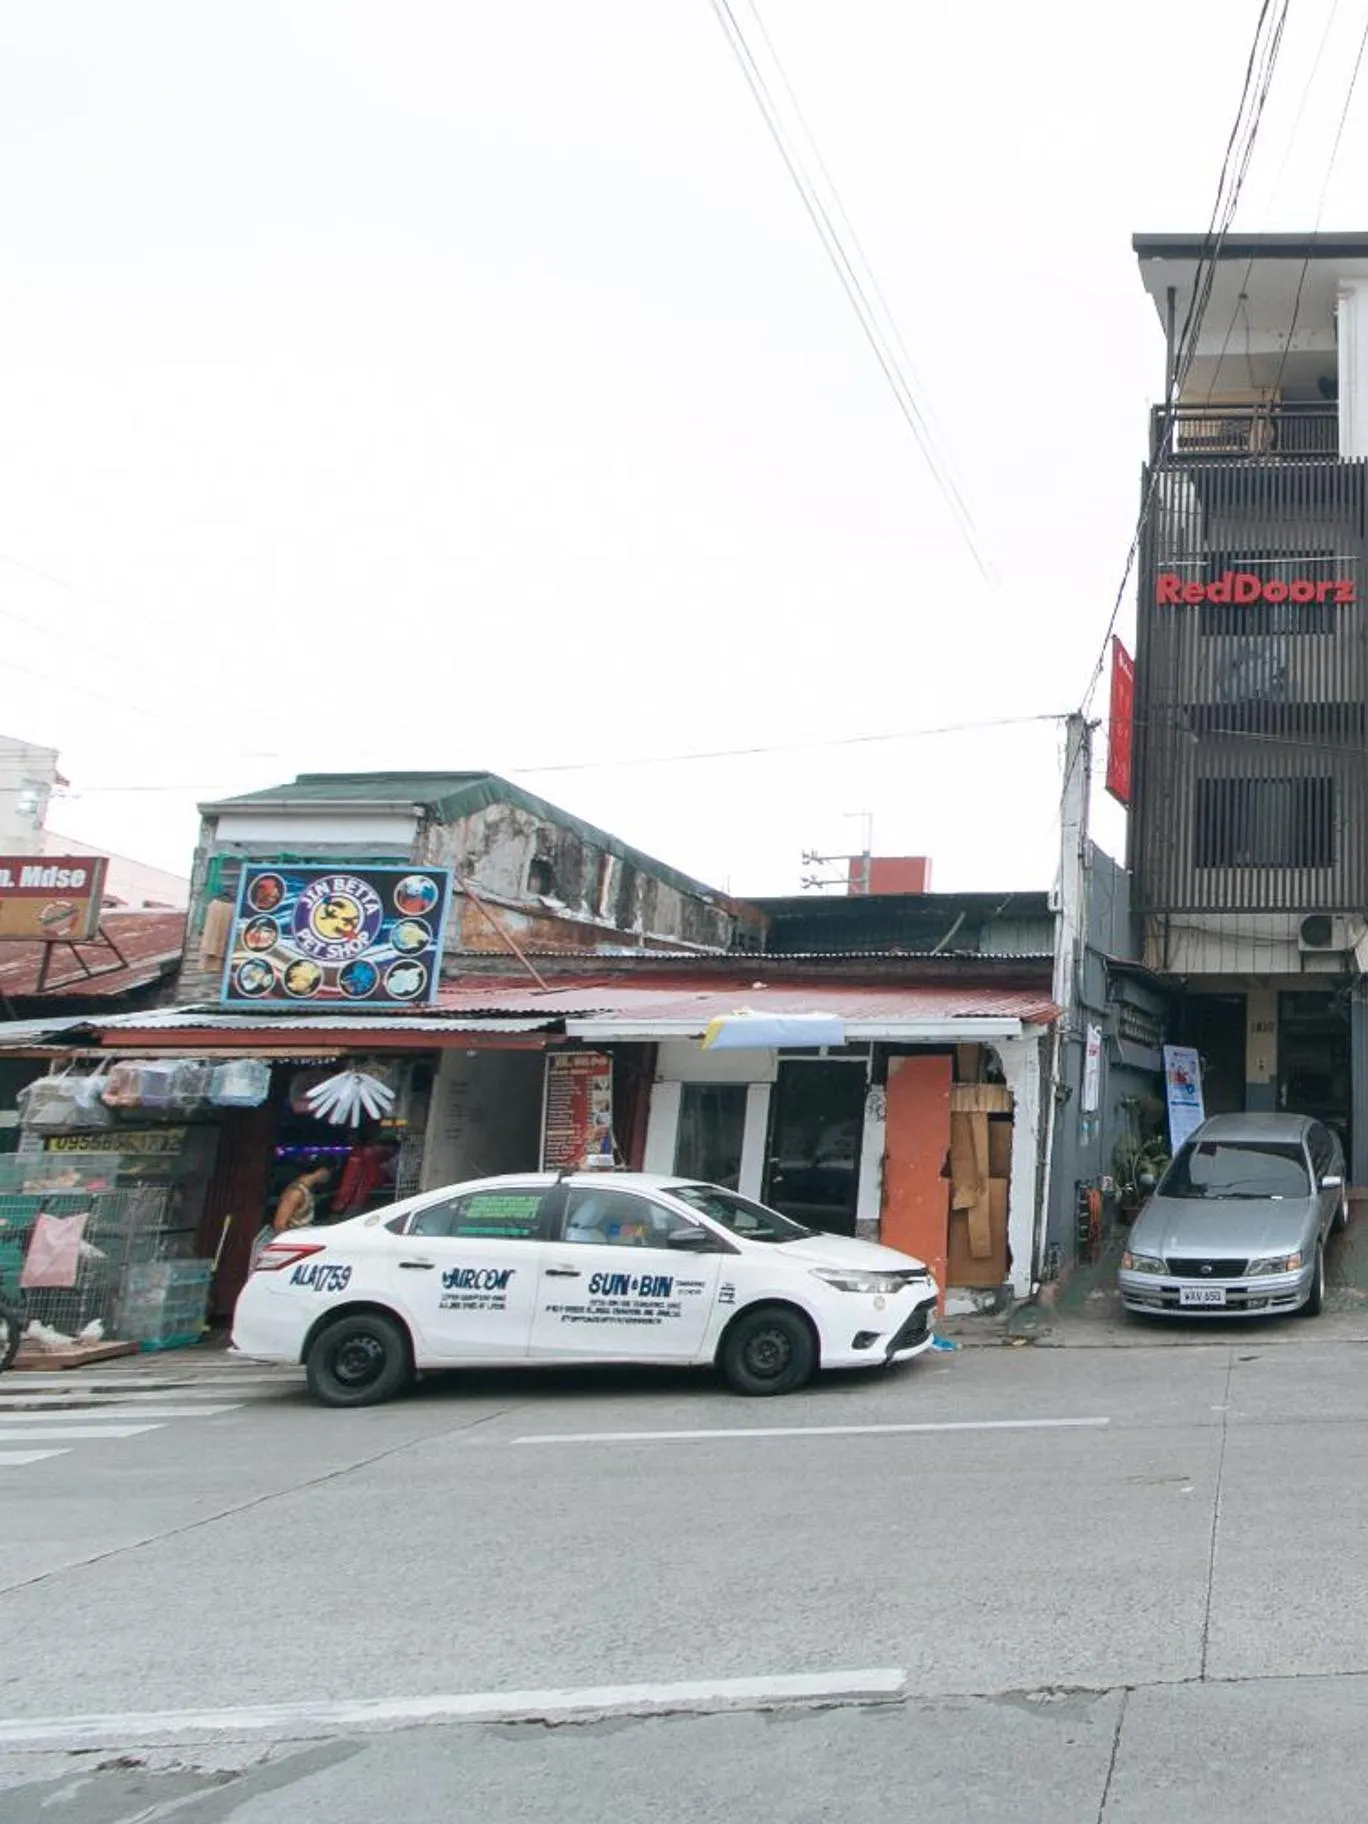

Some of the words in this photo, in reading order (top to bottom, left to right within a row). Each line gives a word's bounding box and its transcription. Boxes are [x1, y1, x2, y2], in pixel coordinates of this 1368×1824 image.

[1156, 570, 1355, 604] RedDoorz
[20, 865, 87, 889] Mdse
[301, 880, 330, 909] JIN
[332, 878, 379, 916] BETTA
[297, 927, 328, 956] PET
[326, 931, 369, 959] SHOP
[442, 1267, 517, 1291] AIRCON
[588, 1272, 631, 1296] SUN
[638, 1274, 674, 1298] BIN
